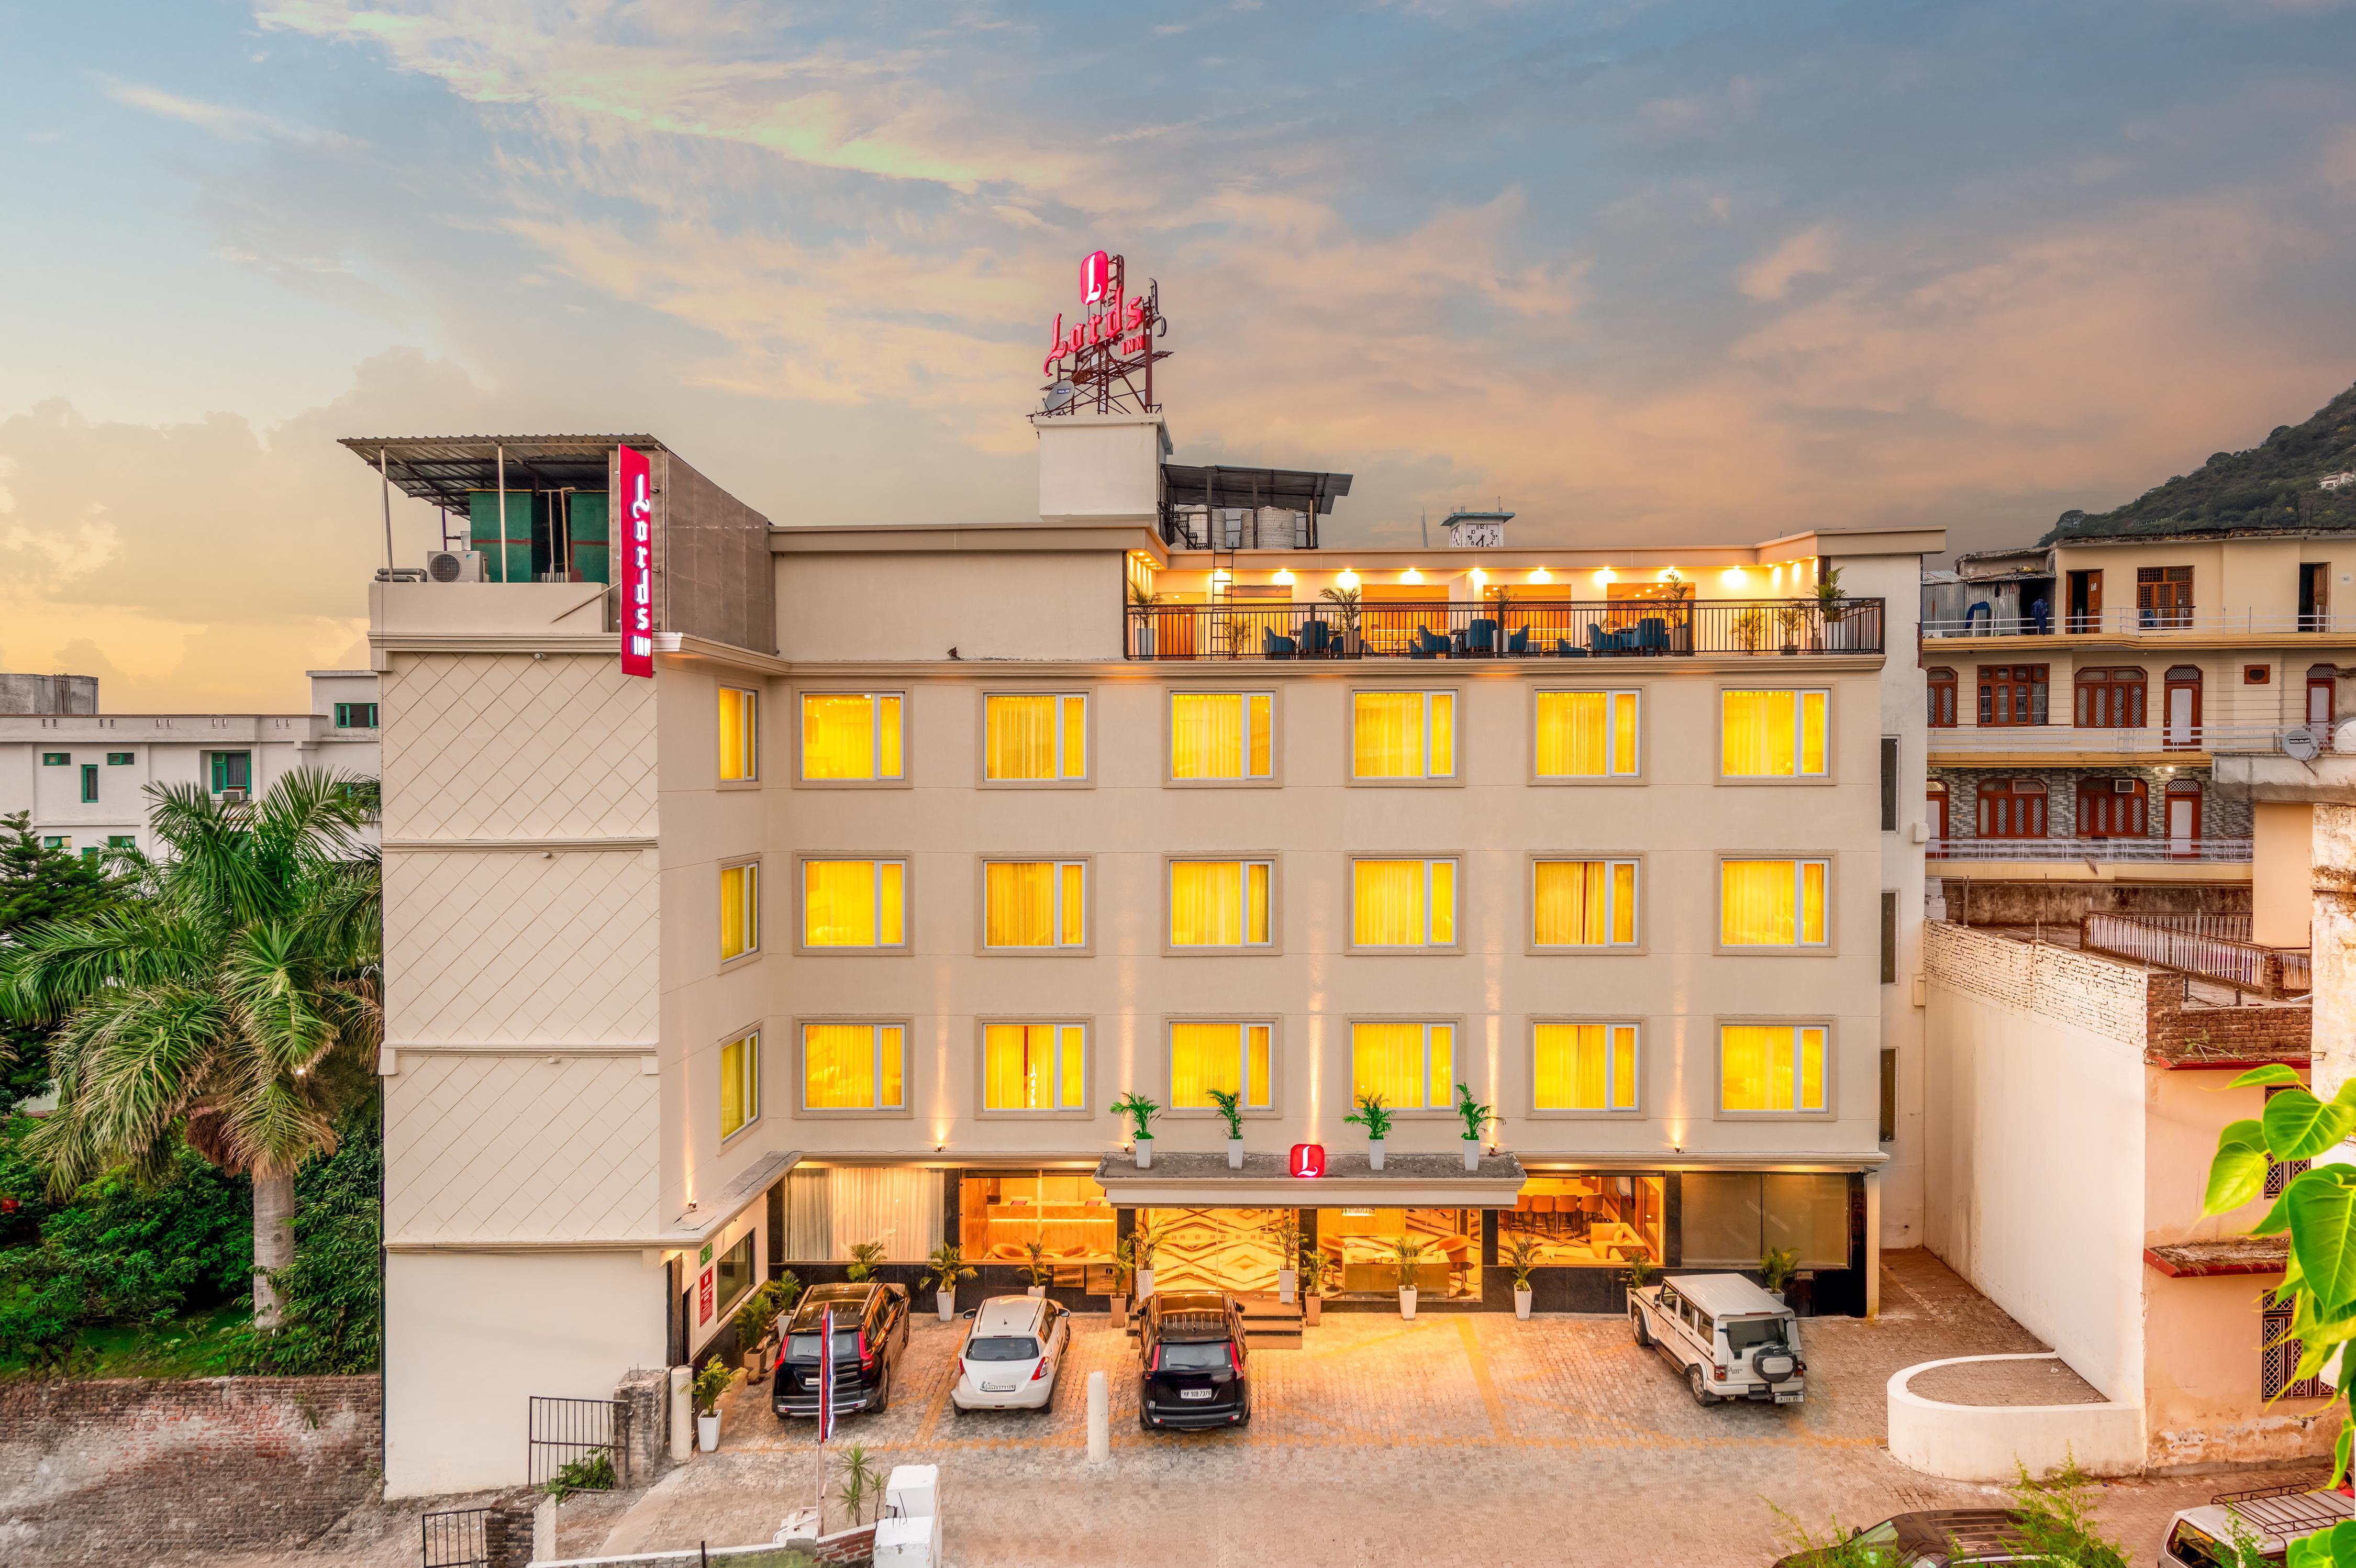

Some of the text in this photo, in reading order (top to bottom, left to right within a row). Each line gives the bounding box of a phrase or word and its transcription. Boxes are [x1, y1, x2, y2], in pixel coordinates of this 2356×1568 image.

[1085, 254, 1102, 304] L
[1043, 285, 1143, 377] Lords
[1121, 336, 1144, 355] INN
[630, 473, 650, 630] Lords
[631, 635, 651, 657] INN
[1297, 1146, 1318, 1176] L
